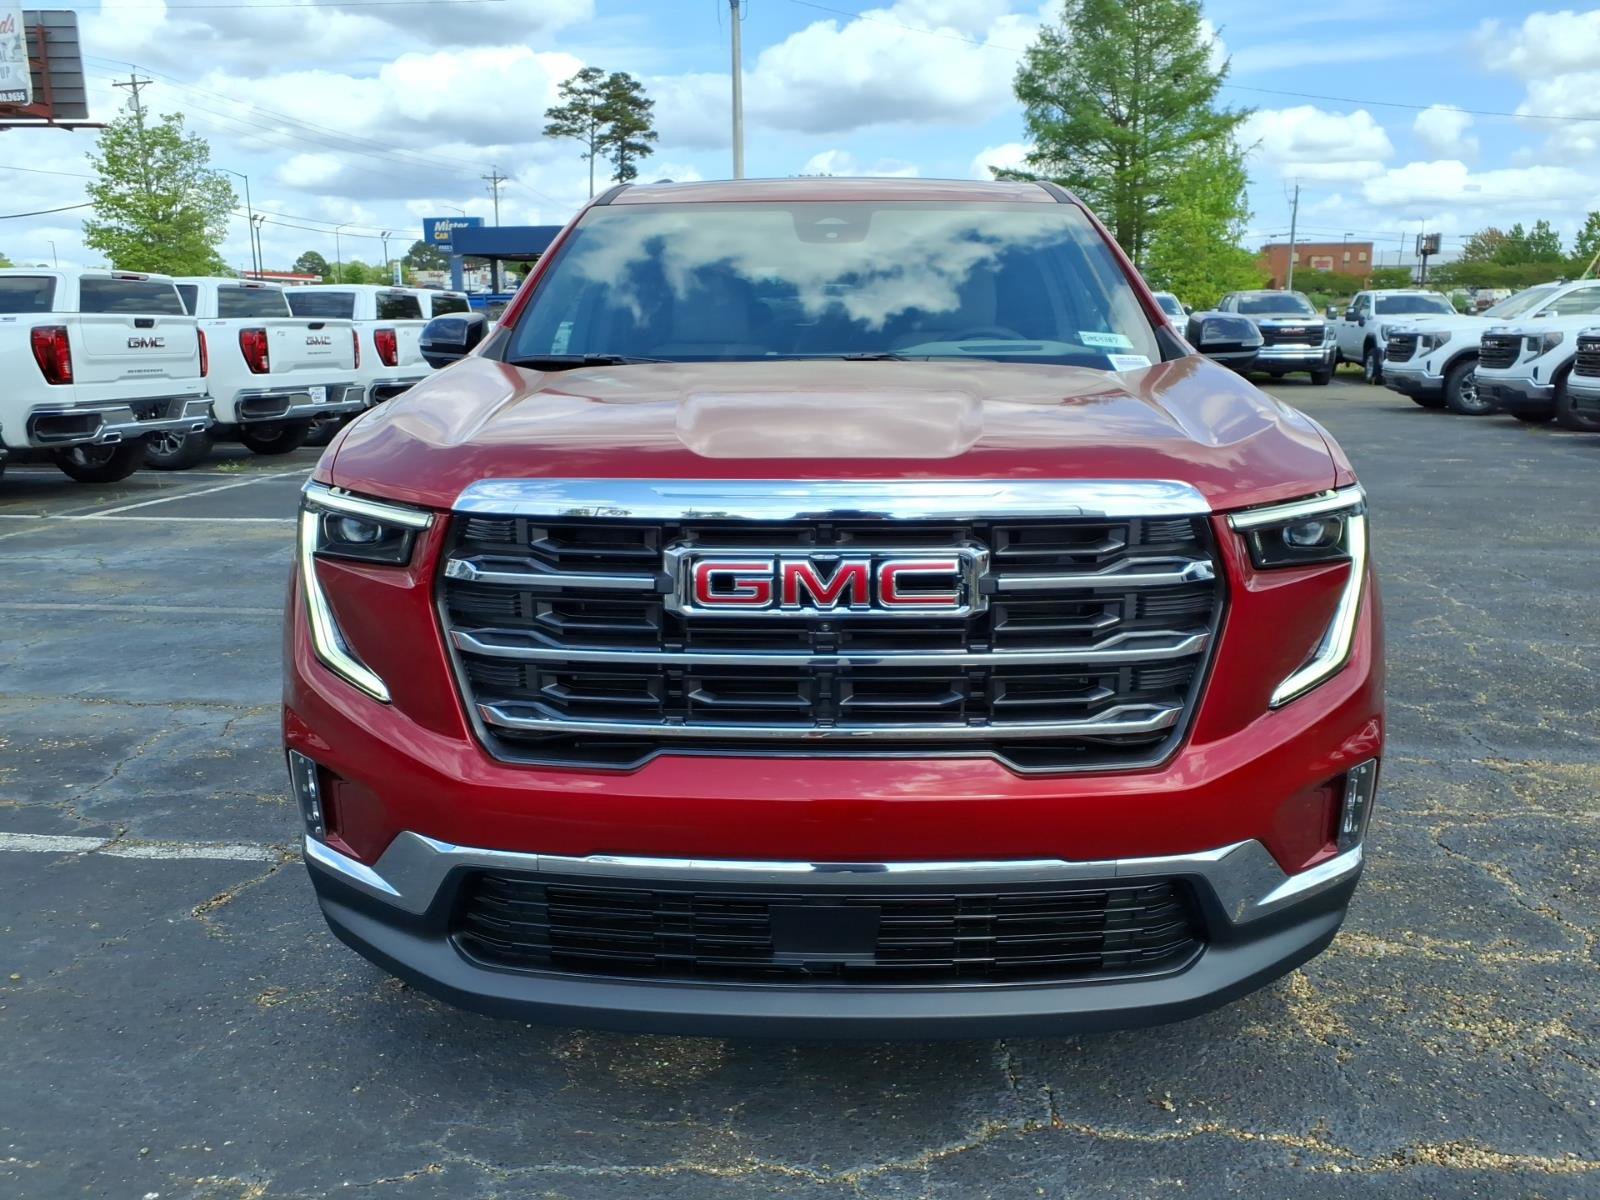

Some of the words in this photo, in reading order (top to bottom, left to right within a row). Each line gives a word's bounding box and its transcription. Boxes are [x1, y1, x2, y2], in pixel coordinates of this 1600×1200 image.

[128, 337, 166, 348] GMC
[305, 336, 332, 345] GMC
[692, 558, 961, 609] GMC
